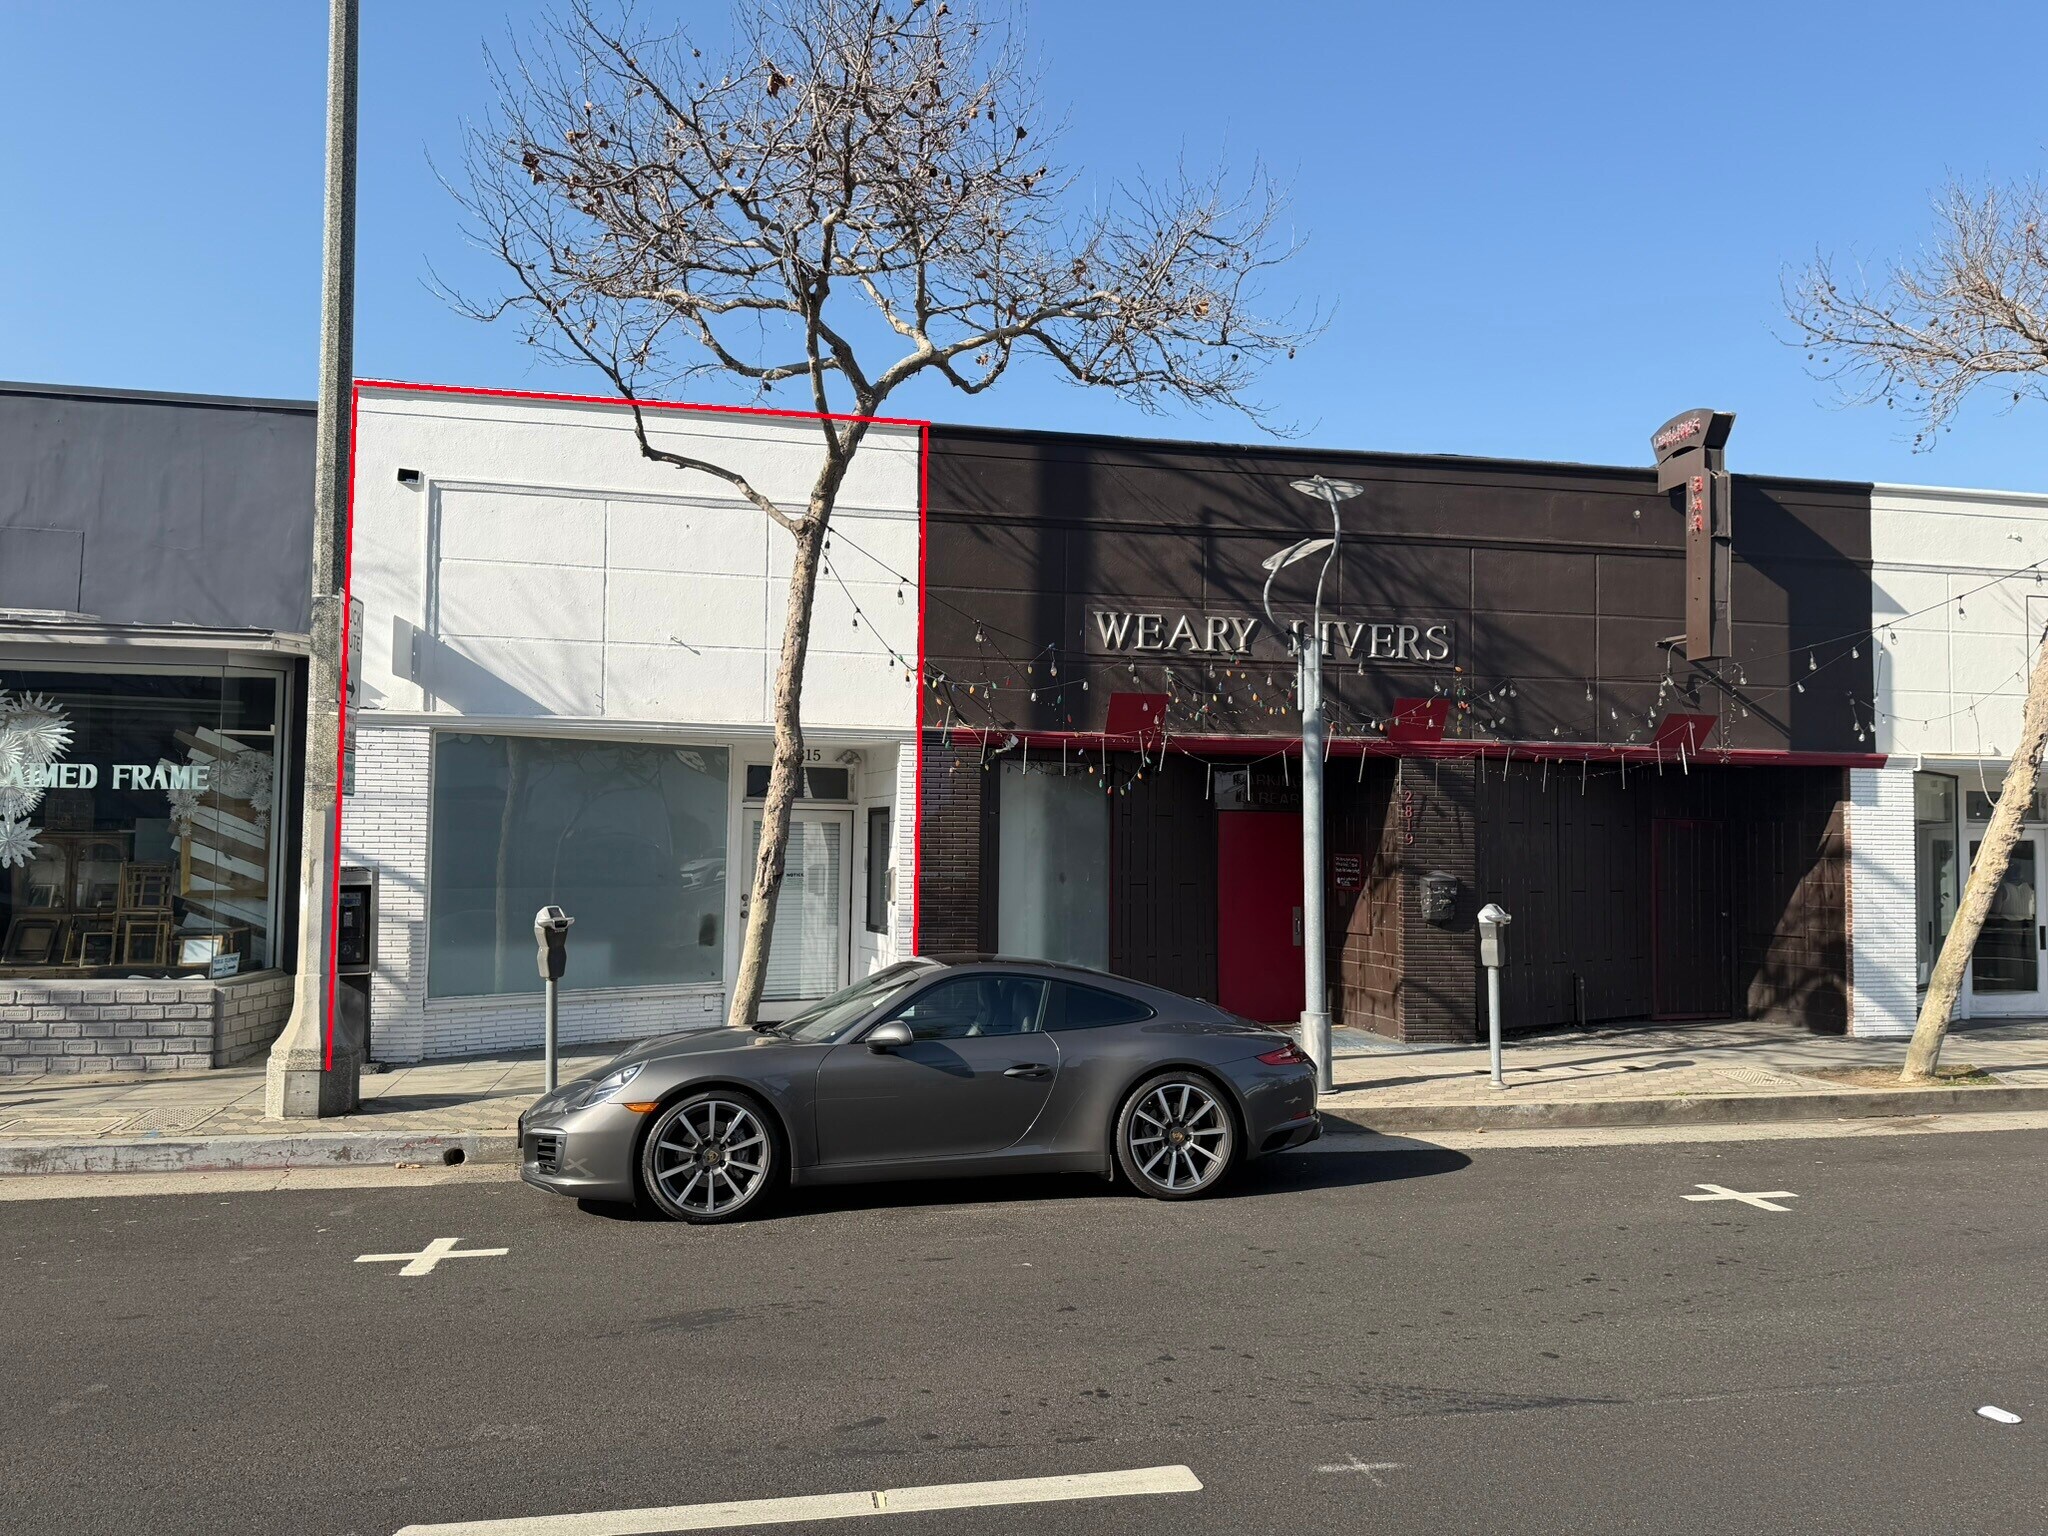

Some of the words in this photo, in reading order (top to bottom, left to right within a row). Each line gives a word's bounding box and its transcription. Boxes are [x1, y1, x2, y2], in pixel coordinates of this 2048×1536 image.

[341, 602, 361, 627] TUCK
[1093, 611, 1258, 653] WEARY
[112, 764, 210, 790] FRAME
[1405, 790, 1413, 845] 2819
